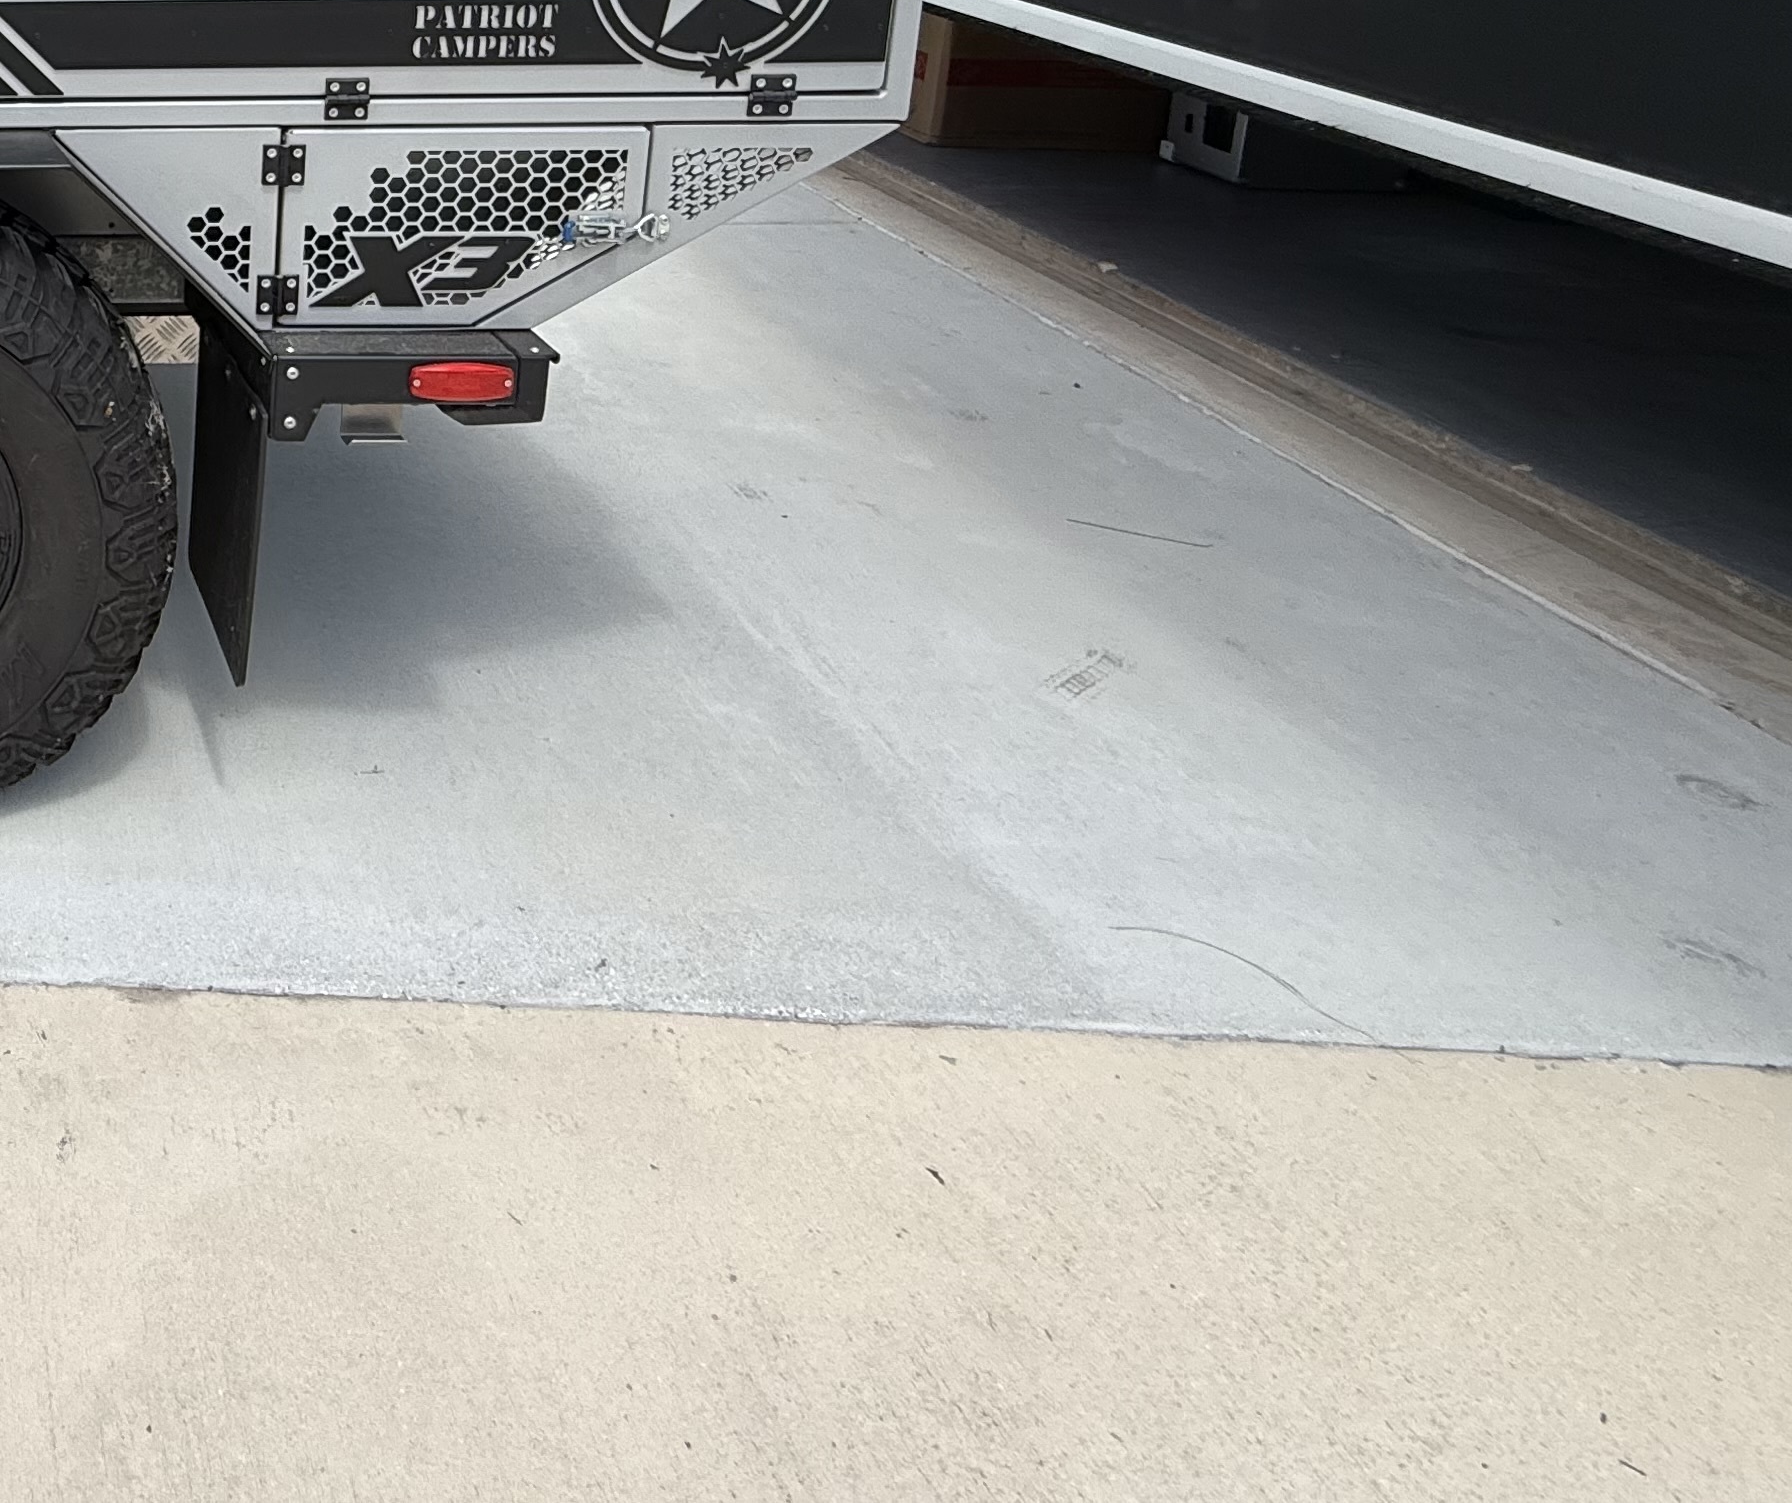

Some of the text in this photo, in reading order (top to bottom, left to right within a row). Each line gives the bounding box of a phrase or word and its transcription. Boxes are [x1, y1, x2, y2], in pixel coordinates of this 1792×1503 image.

[414, 4, 559, 30] PATRIOT
[412, 34, 556, 59] CAMPERS
[309, 235, 537, 308] X3
